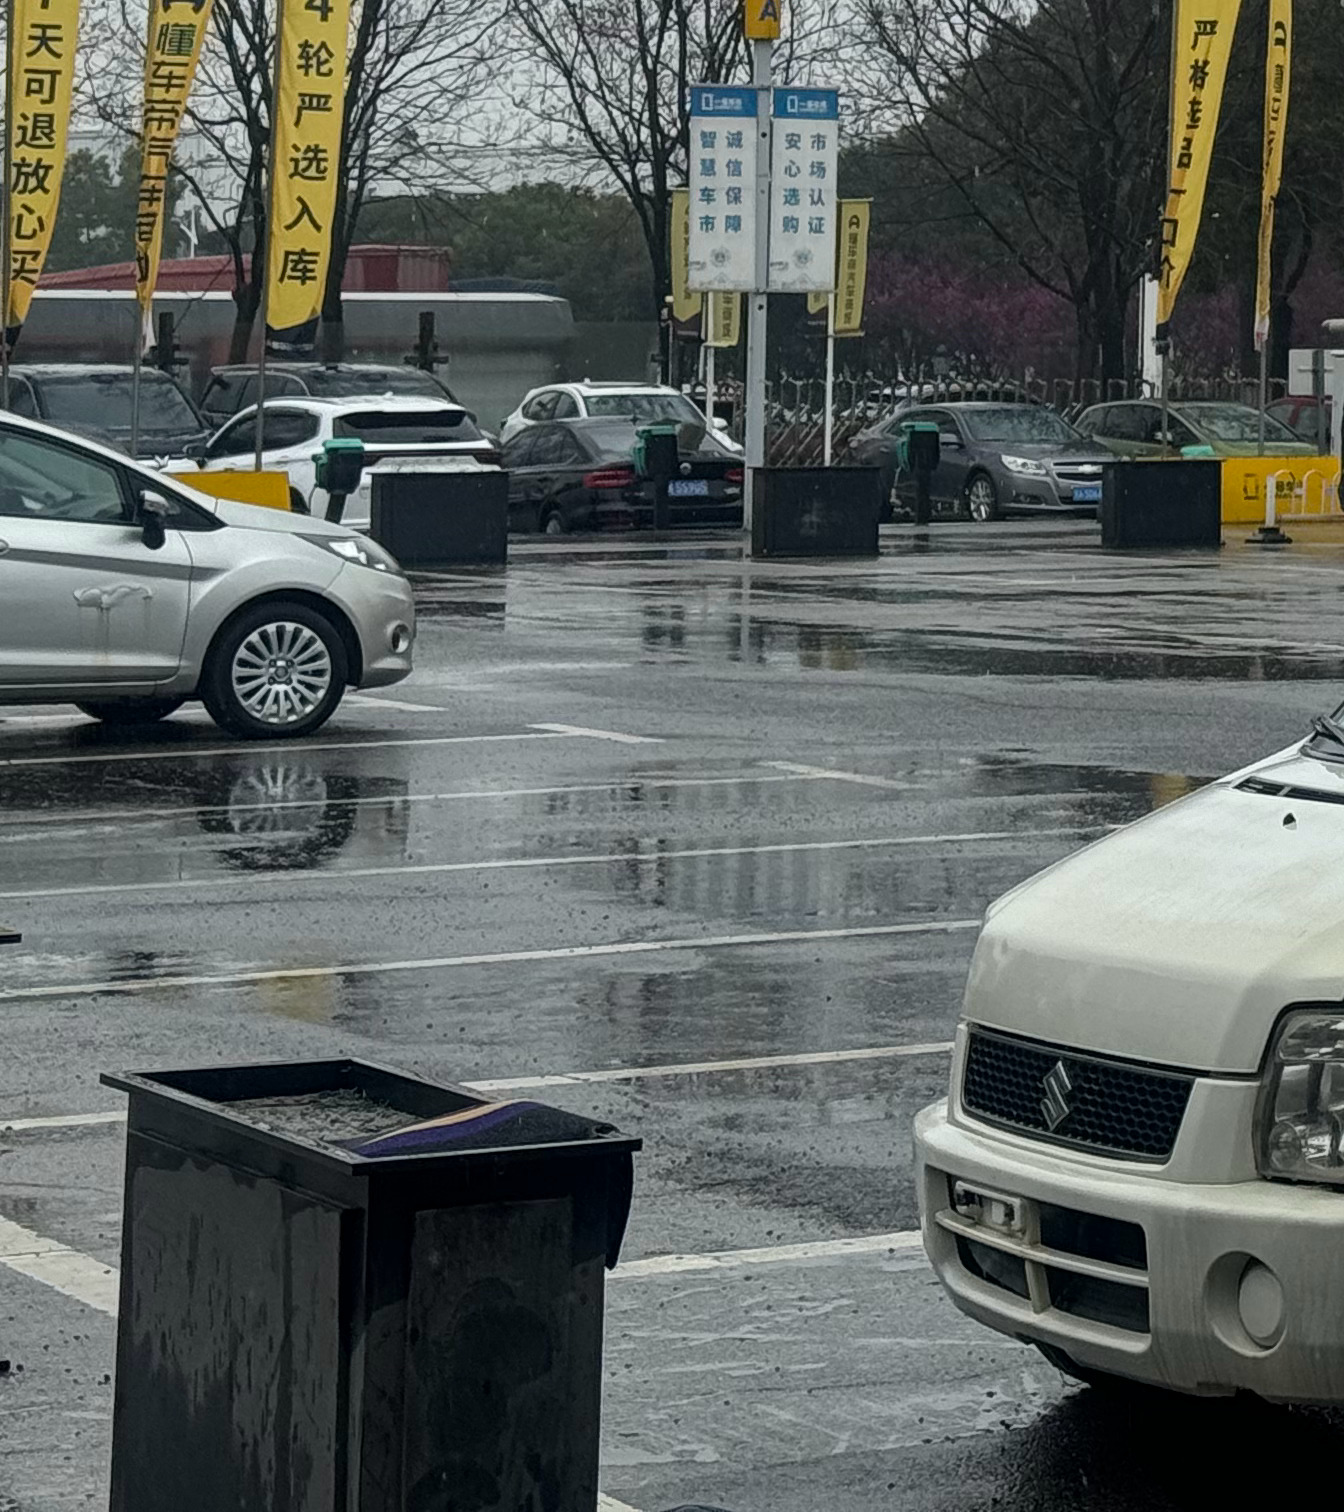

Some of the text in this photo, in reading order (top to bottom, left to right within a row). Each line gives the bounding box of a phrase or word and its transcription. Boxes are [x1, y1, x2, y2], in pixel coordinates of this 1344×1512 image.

[699, 130, 717, 234] 智慧车市
[724, 130, 744, 234] 诚信保障
[782, 132, 802, 235] 安心选购
[807, 133, 827, 236] 市场认证
